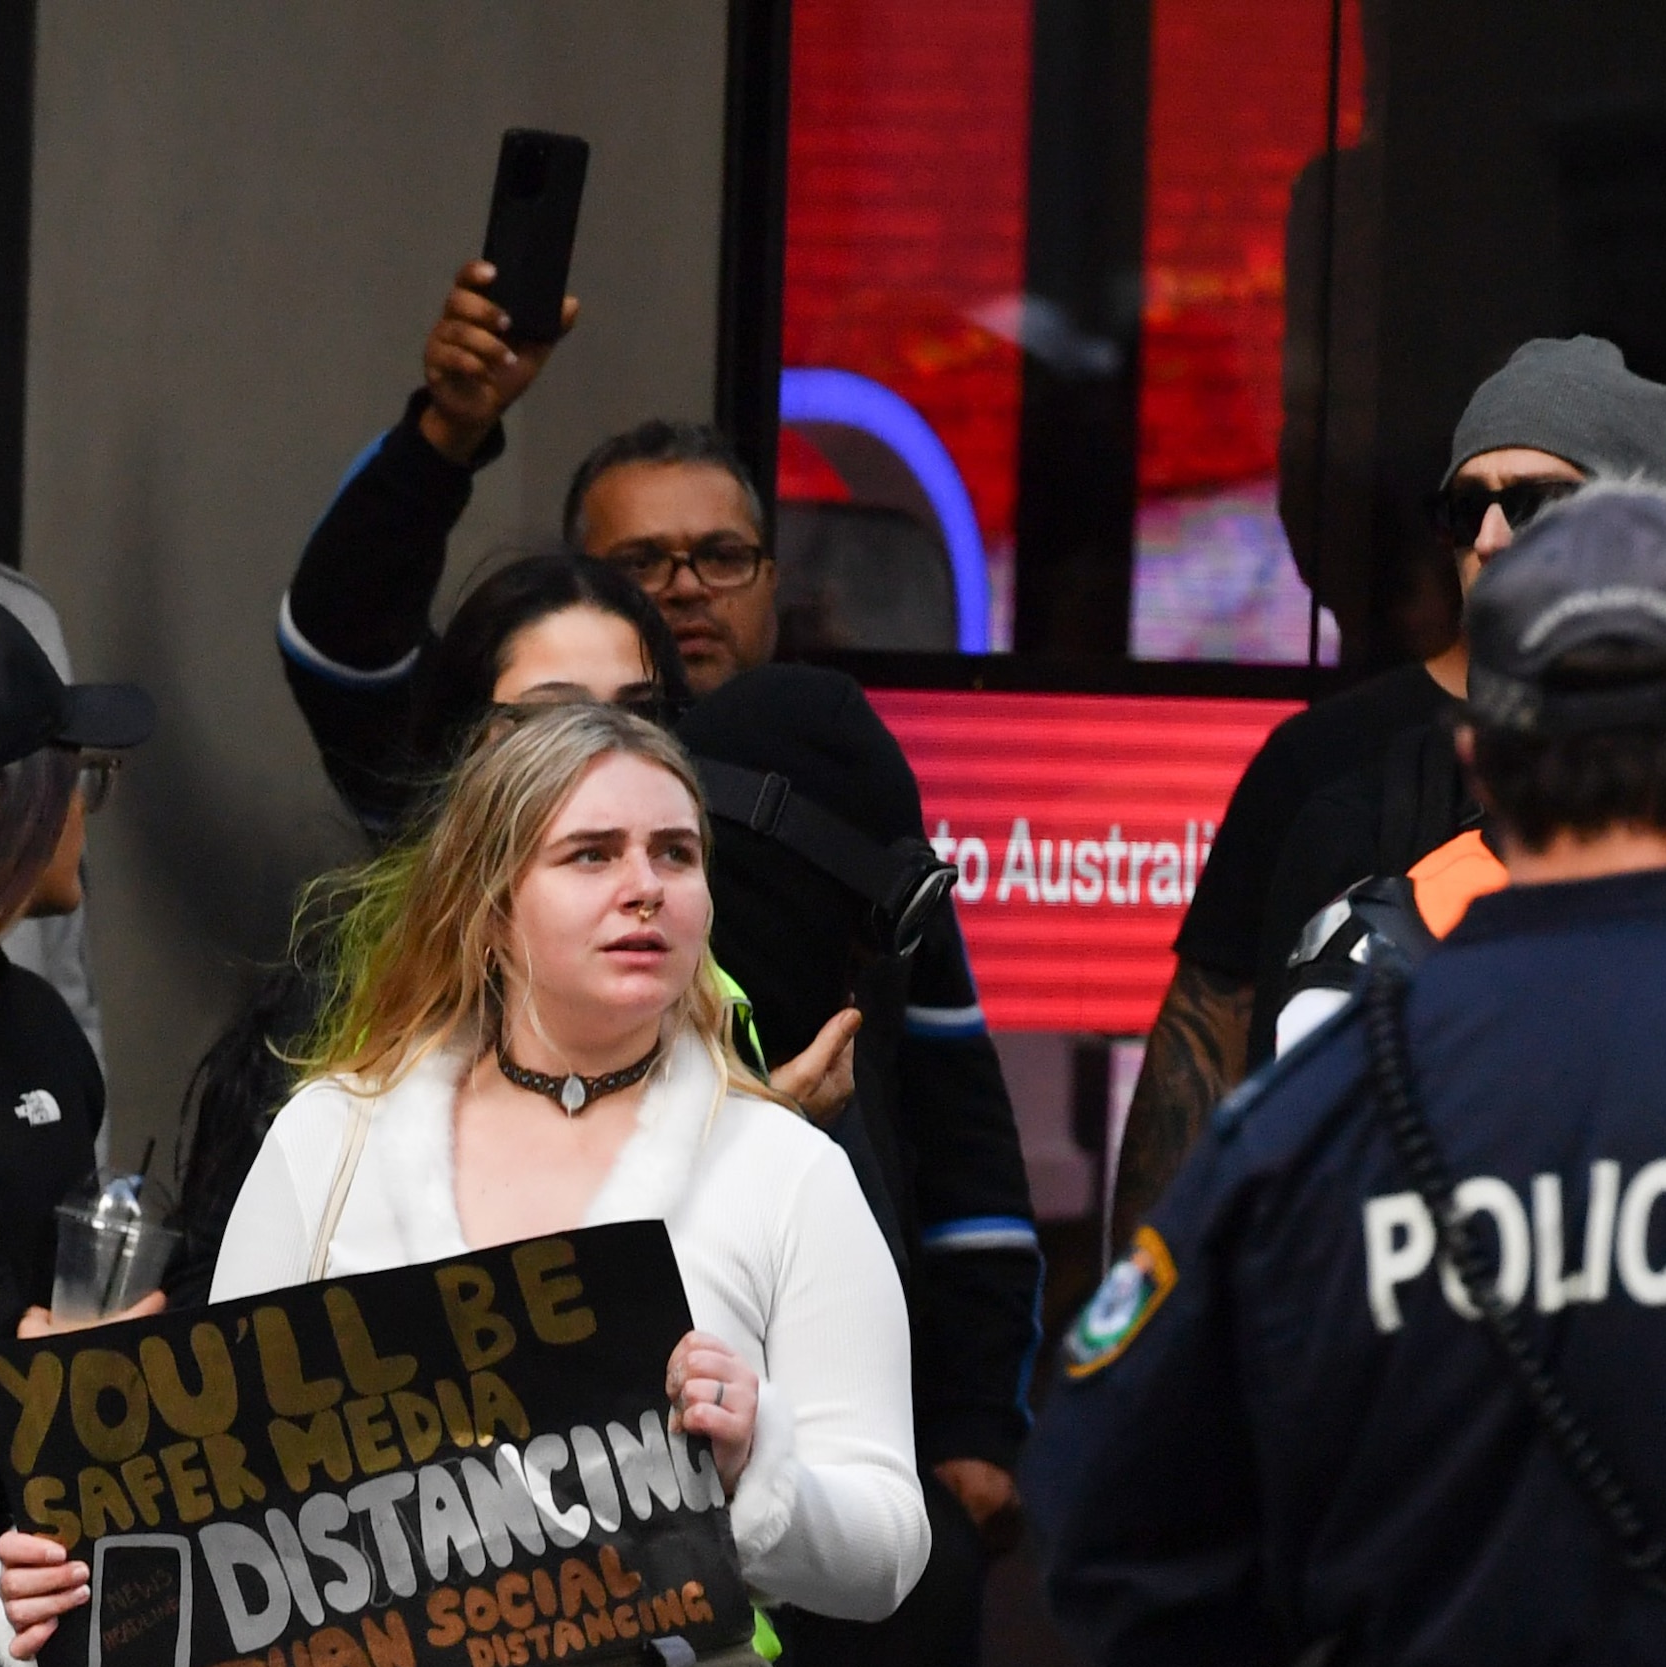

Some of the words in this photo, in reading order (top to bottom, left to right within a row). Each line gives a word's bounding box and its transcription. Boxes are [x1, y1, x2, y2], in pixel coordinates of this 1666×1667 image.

[929, 818, 989, 905] to
[995, 816, 1217, 907] Australi
[435, 1238, 598, 1372] BE
[22, 1433, 266, 1552] SAFER
[267, 1370, 530, 1493] MEDIA
[198, 1408, 726, 1655] DISTANCING
[426, 1544, 643, 1649] SOCIAL
